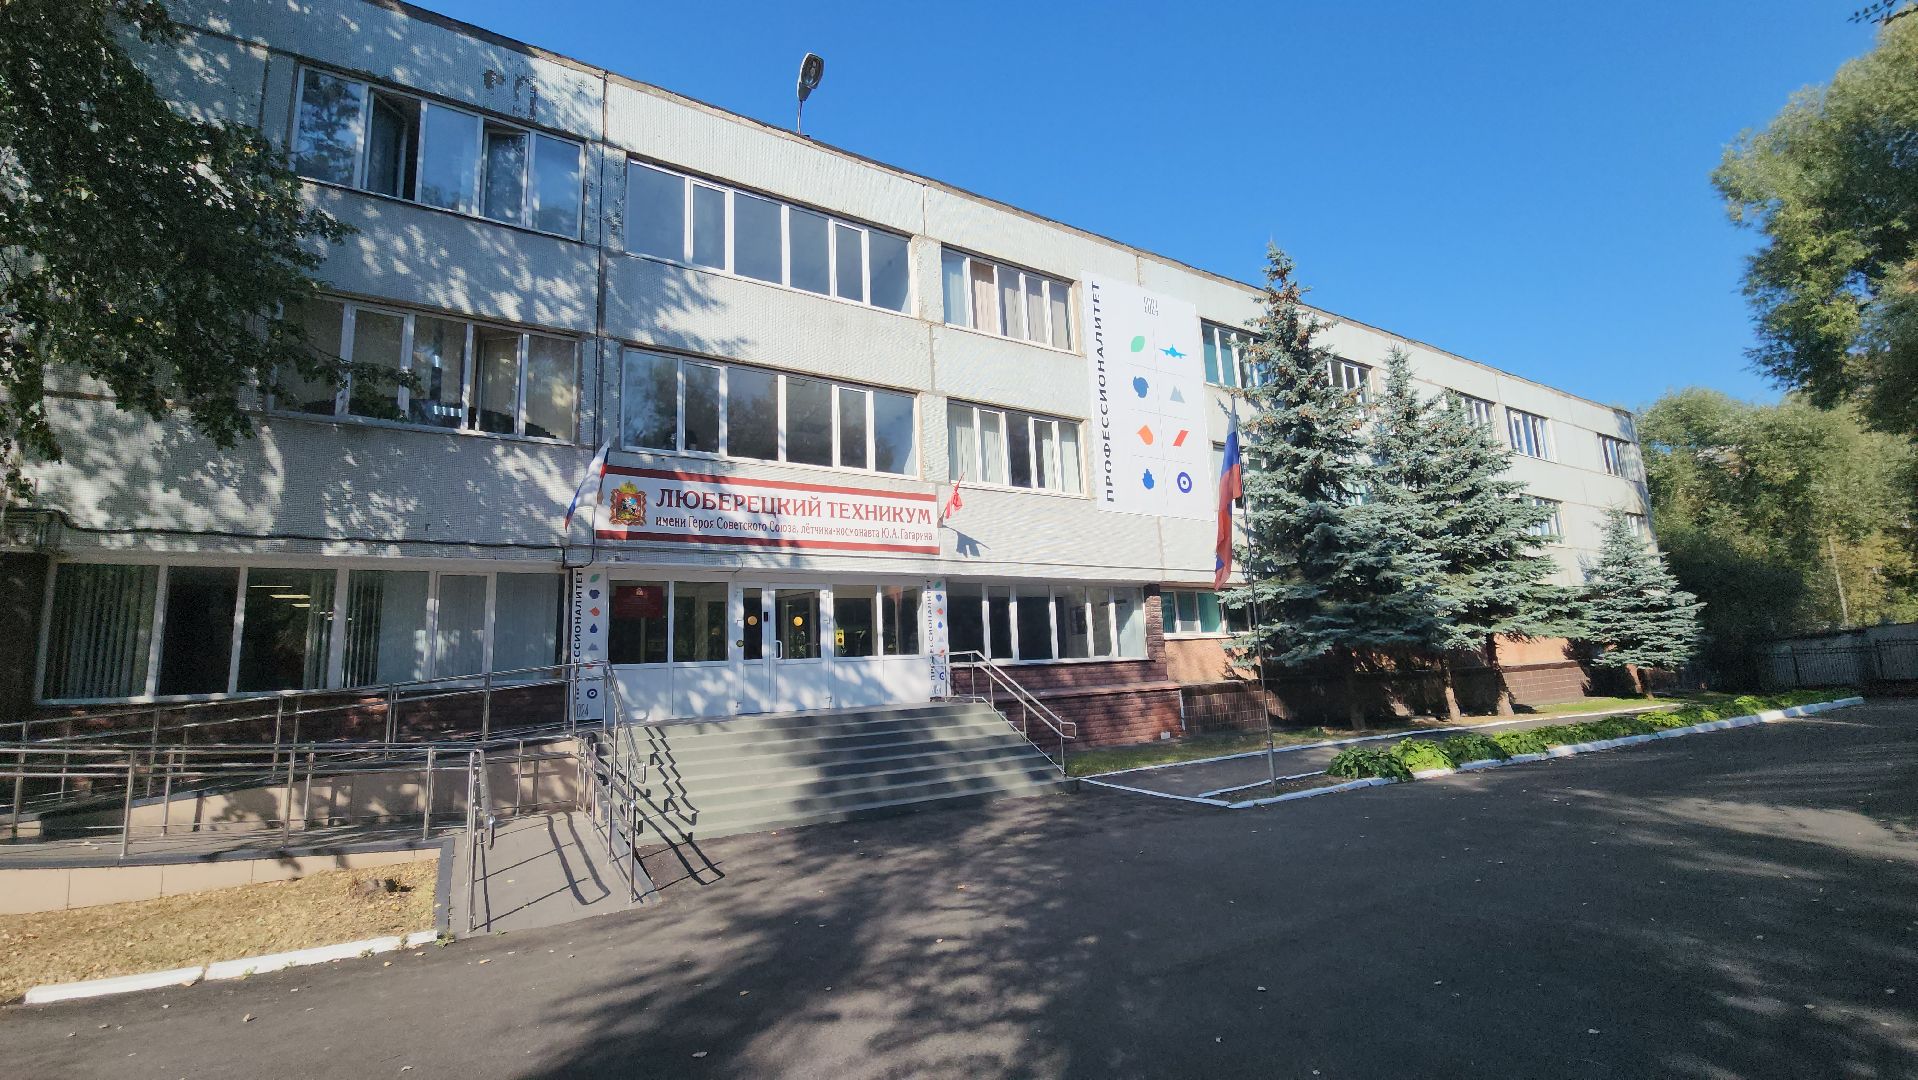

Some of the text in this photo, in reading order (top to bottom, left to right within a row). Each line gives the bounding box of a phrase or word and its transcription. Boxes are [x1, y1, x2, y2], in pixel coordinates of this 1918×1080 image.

[1091, 280, 1114, 502] ПРОФЕССИОНАЛИТЕТ
[655, 488, 932, 525] ЛЮБЕРЕЦКИЙ ТЕХНИКУМ
[655, 516, 686, 527] имени
[688, 515, 715, 531] Героя
[716, 516, 768, 532] Советского
